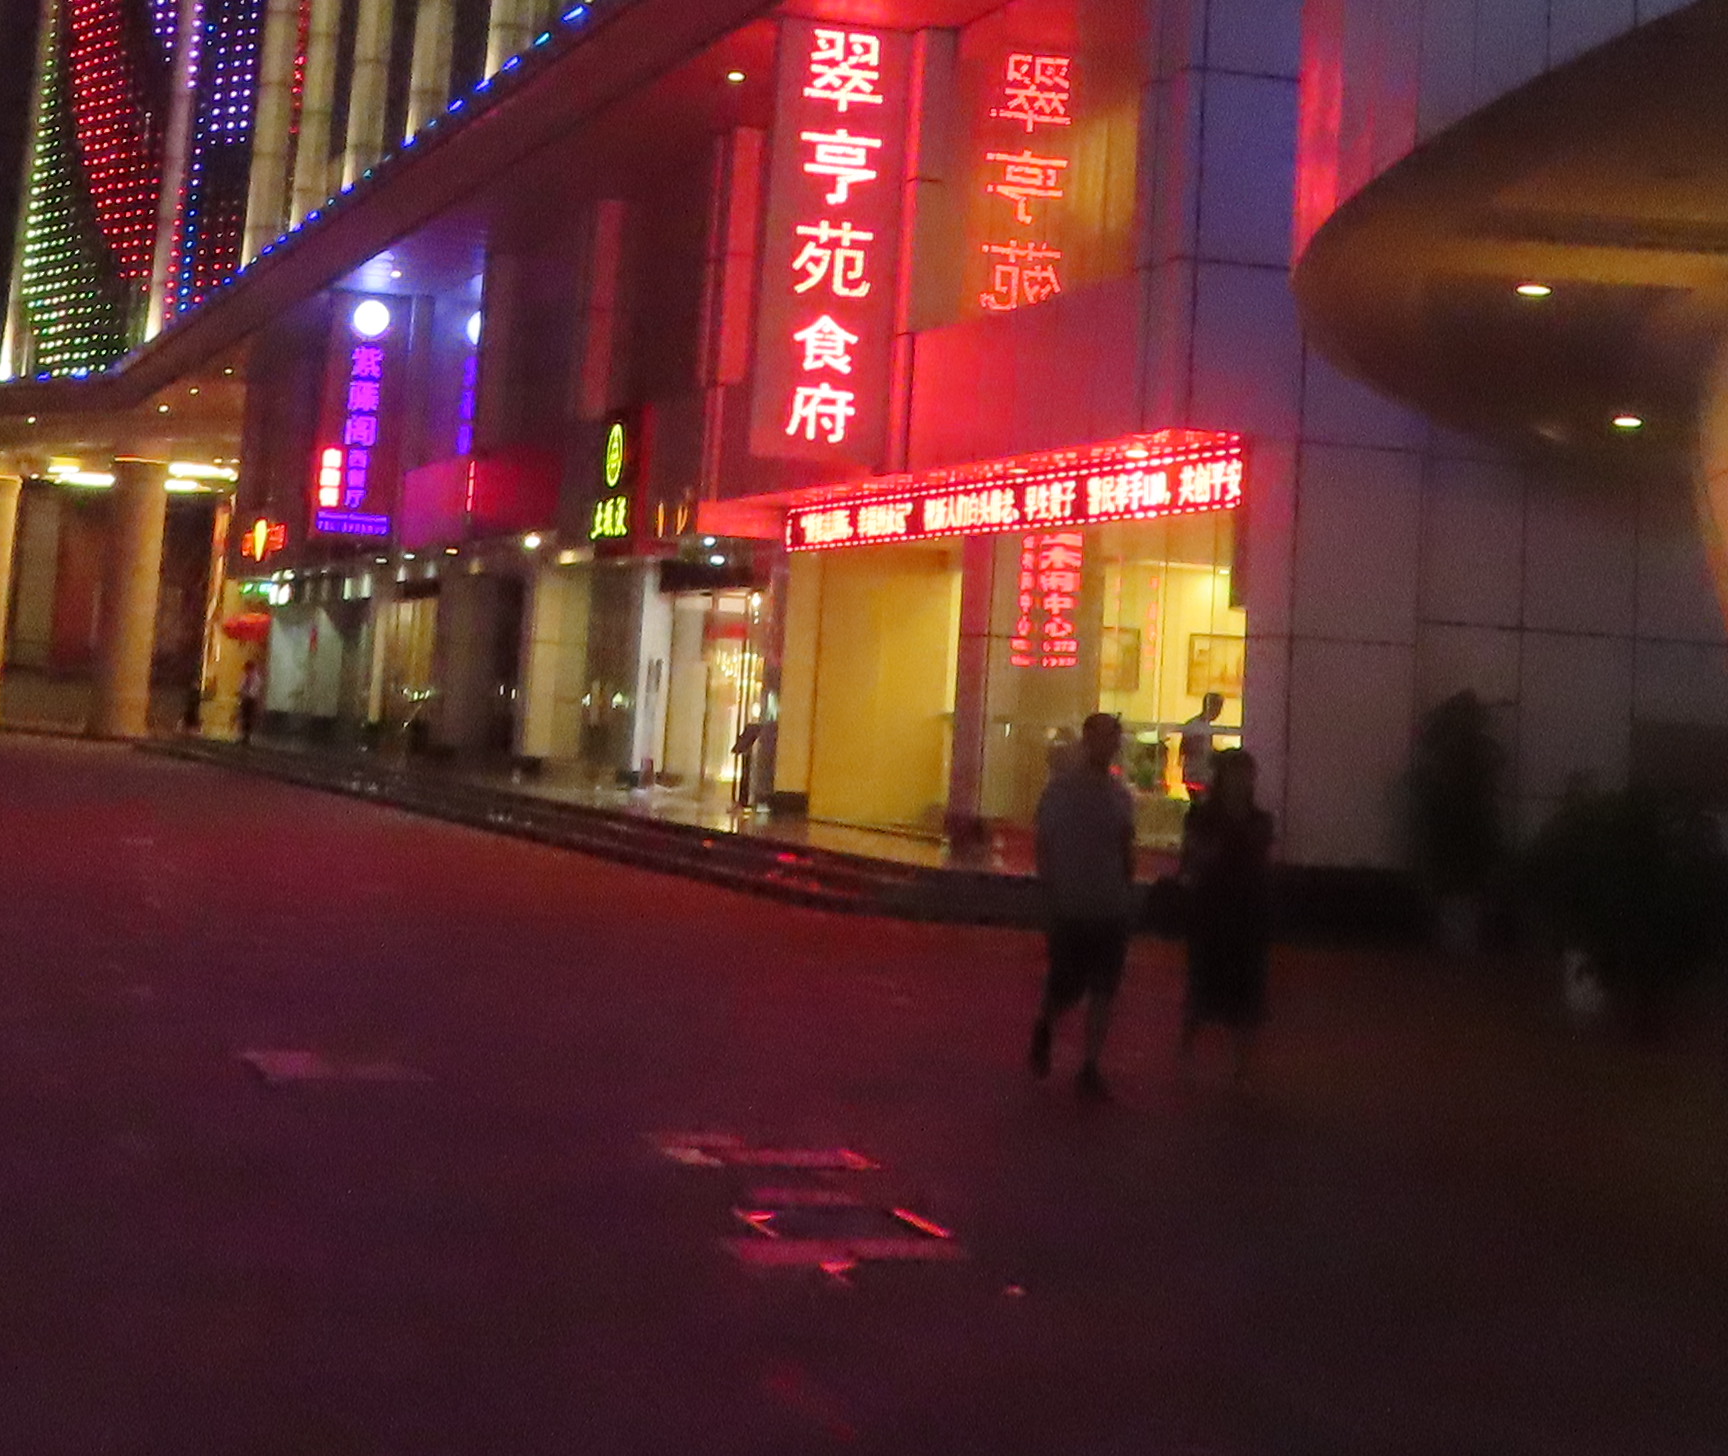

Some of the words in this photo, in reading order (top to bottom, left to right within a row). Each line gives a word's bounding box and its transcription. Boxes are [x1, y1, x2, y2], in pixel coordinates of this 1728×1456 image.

[784, 27, 884, 444] 翠亨苑食府
